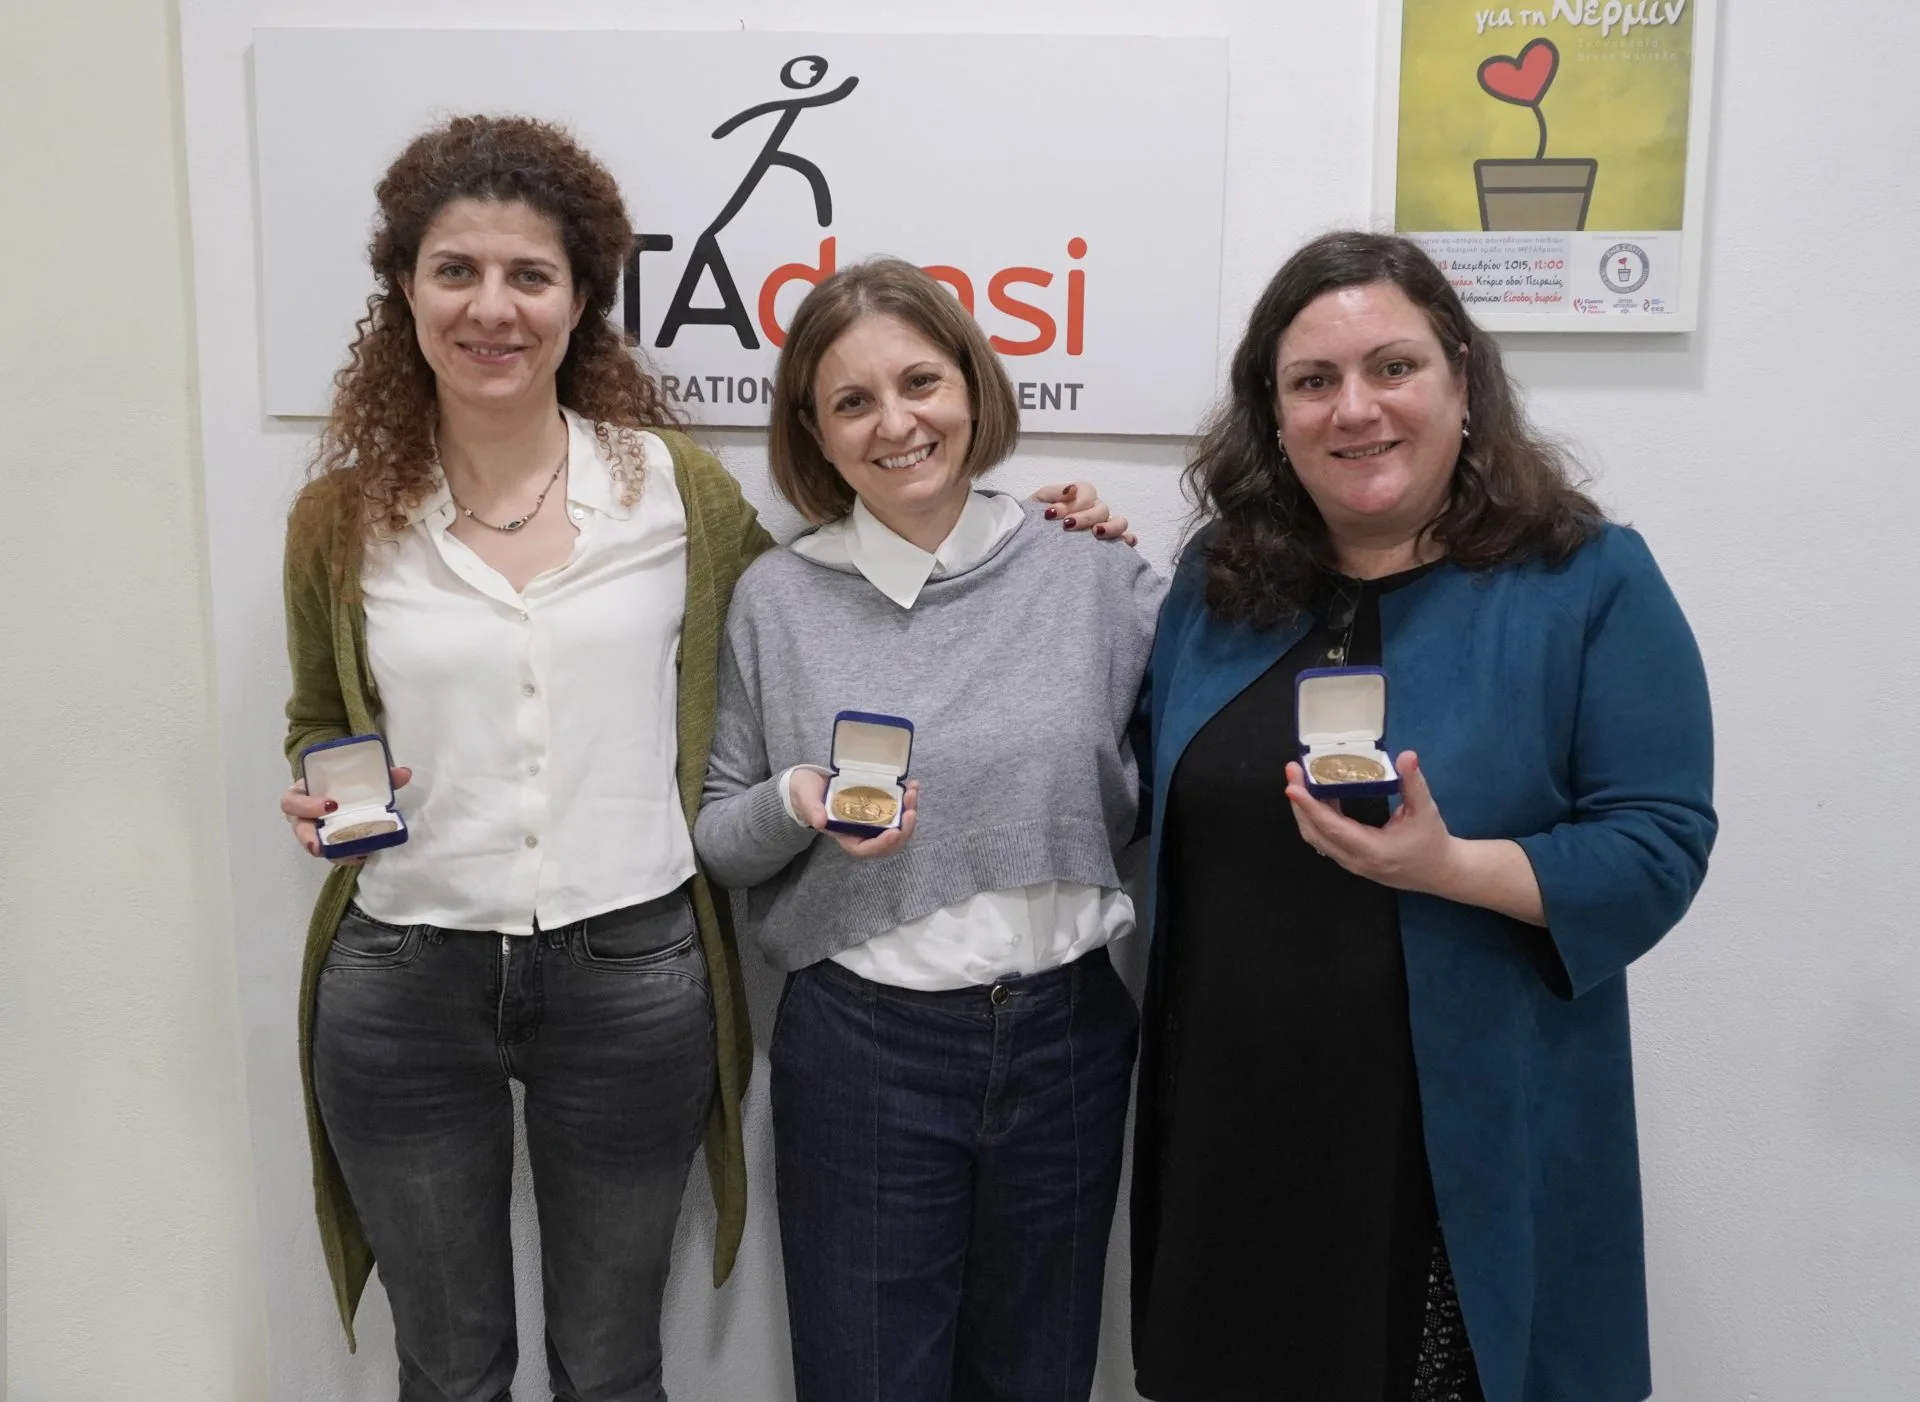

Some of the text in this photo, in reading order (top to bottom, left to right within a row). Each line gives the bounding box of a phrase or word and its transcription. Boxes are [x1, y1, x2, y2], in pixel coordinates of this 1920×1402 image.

[1474, 7, 1515, 35] για
[1519, 8, 1547, 27] τη
[1451, 259, 1501, 272] Δεκεμβρίου
[1505, 259, 1531, 272] 2015,
[1534, 259, 1564, 270] 12:00
[1506, 275, 1523, 286] οδού
[1526, 273, 1563, 288] Πειραιώς
[1503, 290, 1533, 305] Είσοδος
[1535, 291, 1563, 304] δωρεάν
[660, 374, 776, 404] RATION
